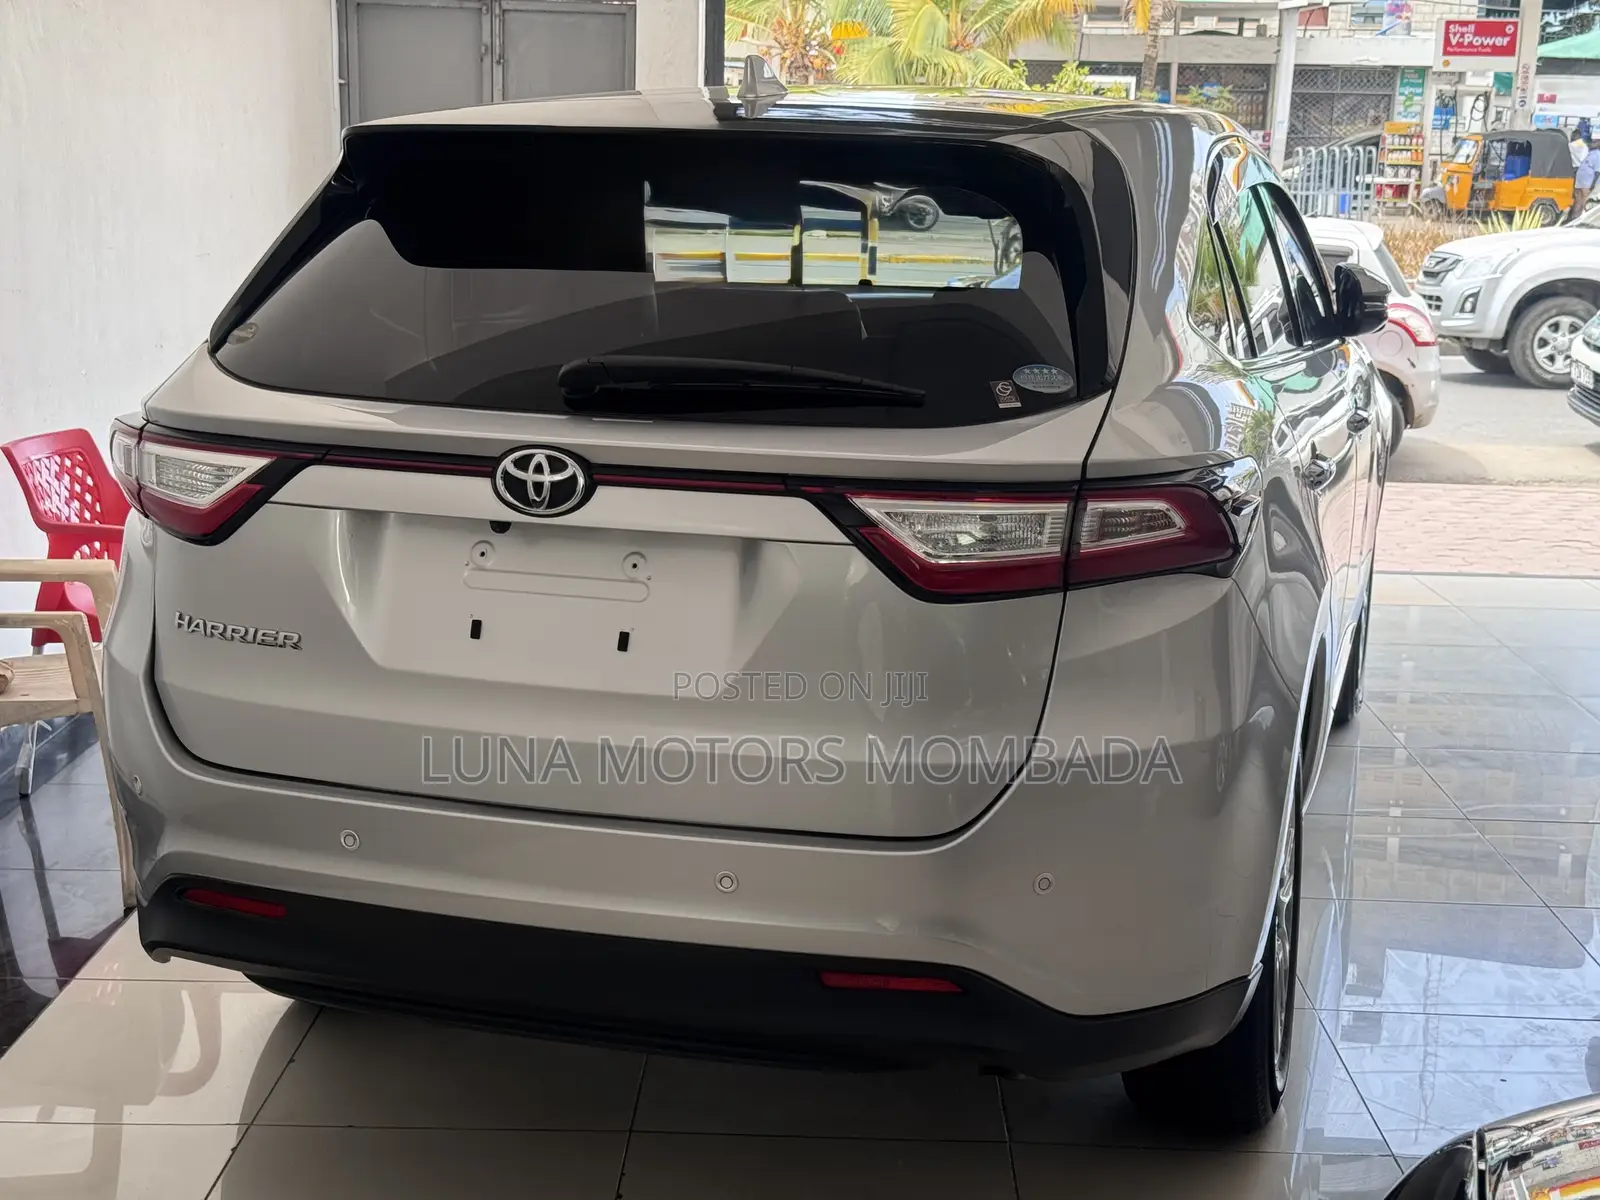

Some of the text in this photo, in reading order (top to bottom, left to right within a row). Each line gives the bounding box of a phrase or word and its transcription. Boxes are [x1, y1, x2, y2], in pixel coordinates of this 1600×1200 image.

[1449, 24, 1475, 33] Shell
[1449, 33, 1511, 46] V-Power
[175, 610, 302, 650] HARRIER
